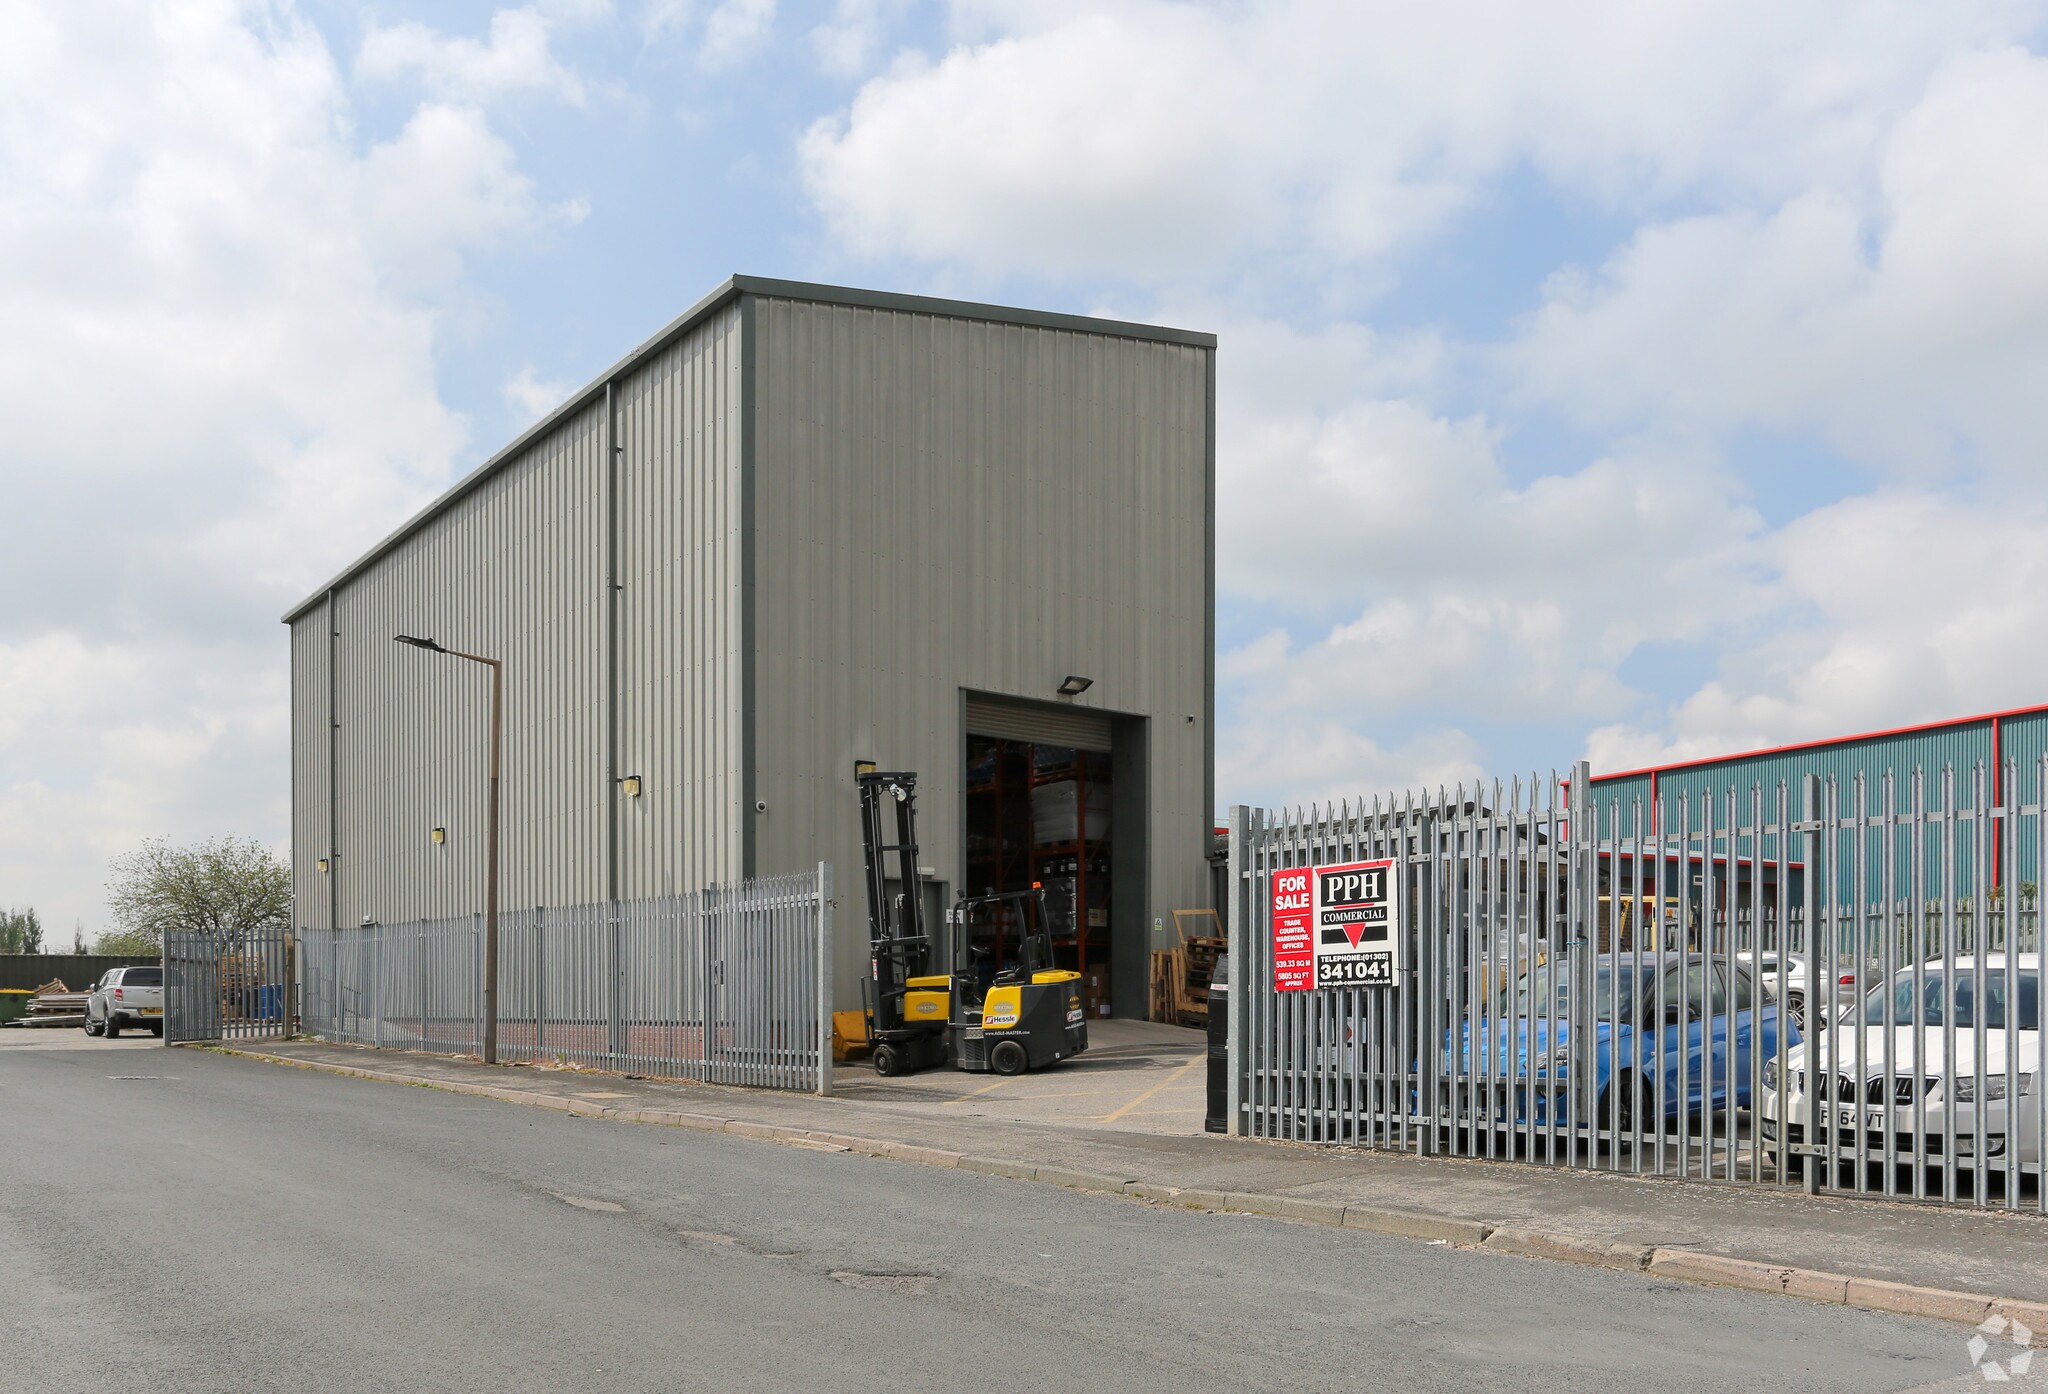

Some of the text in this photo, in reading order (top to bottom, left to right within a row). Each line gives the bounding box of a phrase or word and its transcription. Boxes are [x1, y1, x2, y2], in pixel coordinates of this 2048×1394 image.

[1278, 876, 1306, 892] FOR
[1326, 872, 1380, 902] PPH
[1275, 892, 1310, 911] SALE
[1323, 910, 1384, 922] COMMERCIAL
[1283, 919, 1302, 927] TRADE
[1279, 926, 1306, 935] COUNTER,
[1275, 934, 1310, 943] WAREHOUSE,
[1281, 942, 1304, 950] OFFICES
[1276, 959, 1296, 968] 539.33
[1320, 962, 1389, 979] 341041
[1277, 972, 1292, 980] 5805
[1302, 971, 1310, 979] FT
[1319, 979, 1391, 987] www.pph-commercial.co.uk
[993, 1015, 1016, 1023] Hessle
